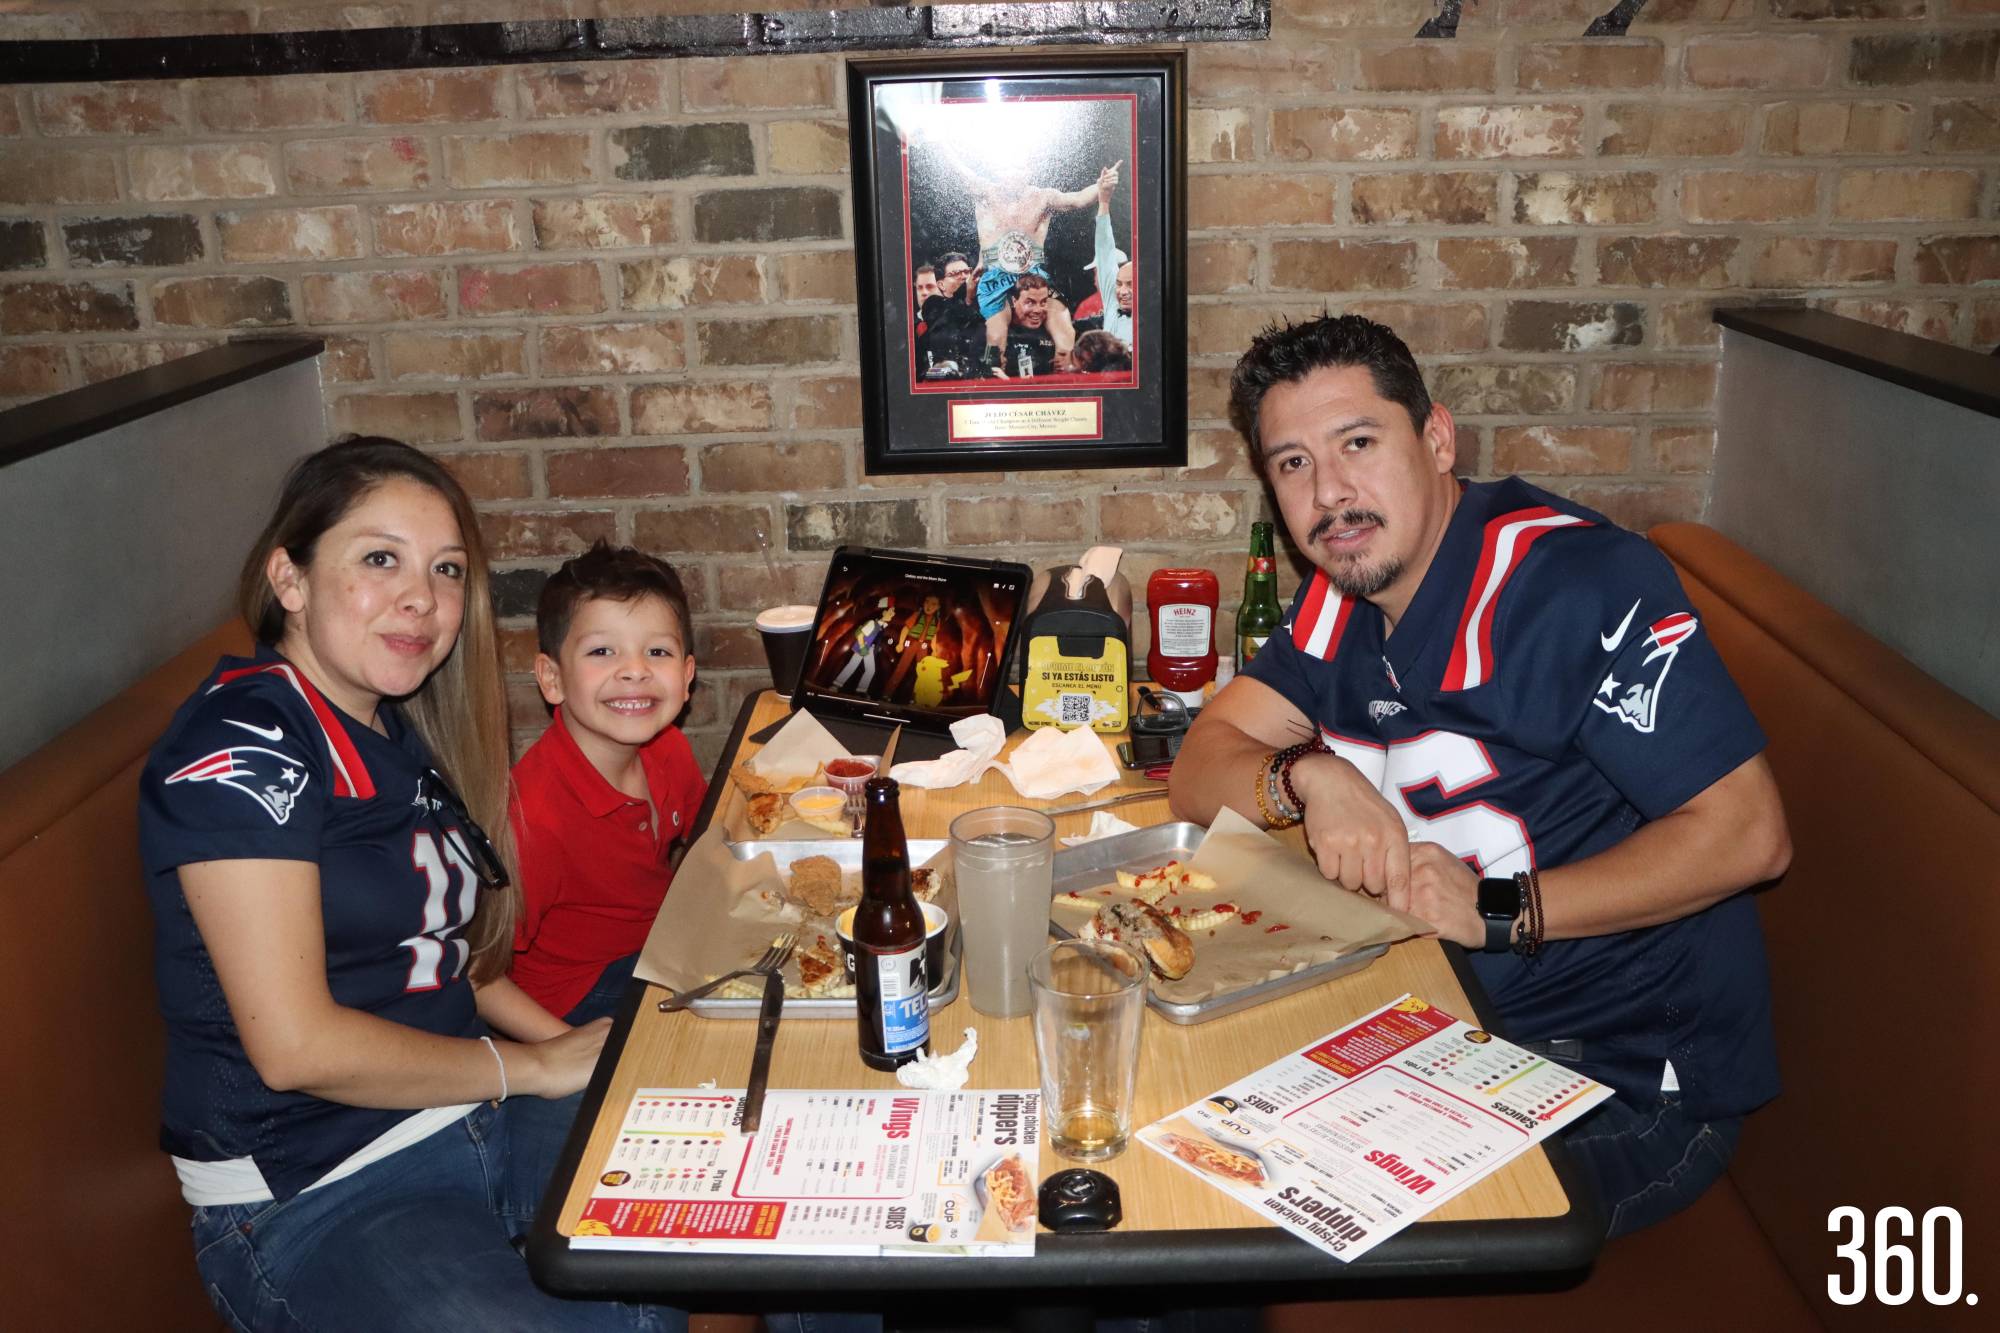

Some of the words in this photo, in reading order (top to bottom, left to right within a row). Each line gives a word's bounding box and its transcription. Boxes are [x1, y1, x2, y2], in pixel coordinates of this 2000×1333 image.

[1173, 607, 1197, 616] HEINZ
[1042, 672, 1050, 680] SI
[1052, 672, 1063, 681] YA
[1064, 671, 1089, 682] ESTÁS
[1091, 674, 1115, 682] LISTO
[1402, 1059, 1422, 1069] rubs
[1420, 1067, 1435, 1076] Dry
[1022, 1093, 1039, 1113] Crispy
[1243, 1094, 1278, 1113] SIDES
[880, 1097, 919, 1138] Wings
[987, 1094, 1023, 1145] dippers
[1491, 1101, 1538, 1128] Sauces
[1022, 1115, 1038, 1144] chicken
[1220, 1119, 1250, 1135] CUP
[713, 1169, 727, 1178] Dry
[1364, 1150, 1434, 1193] Wings
[710, 1180, 723, 1191] rubs
[884, 1206, 906, 1229] SIDES
[943, 1200, 954, 1222] CUP
[1264, 1198, 1308, 1225] chicken
[1278, 1187, 1366, 1241] dippers
[1306, 1221, 1346, 1251] Crispy
